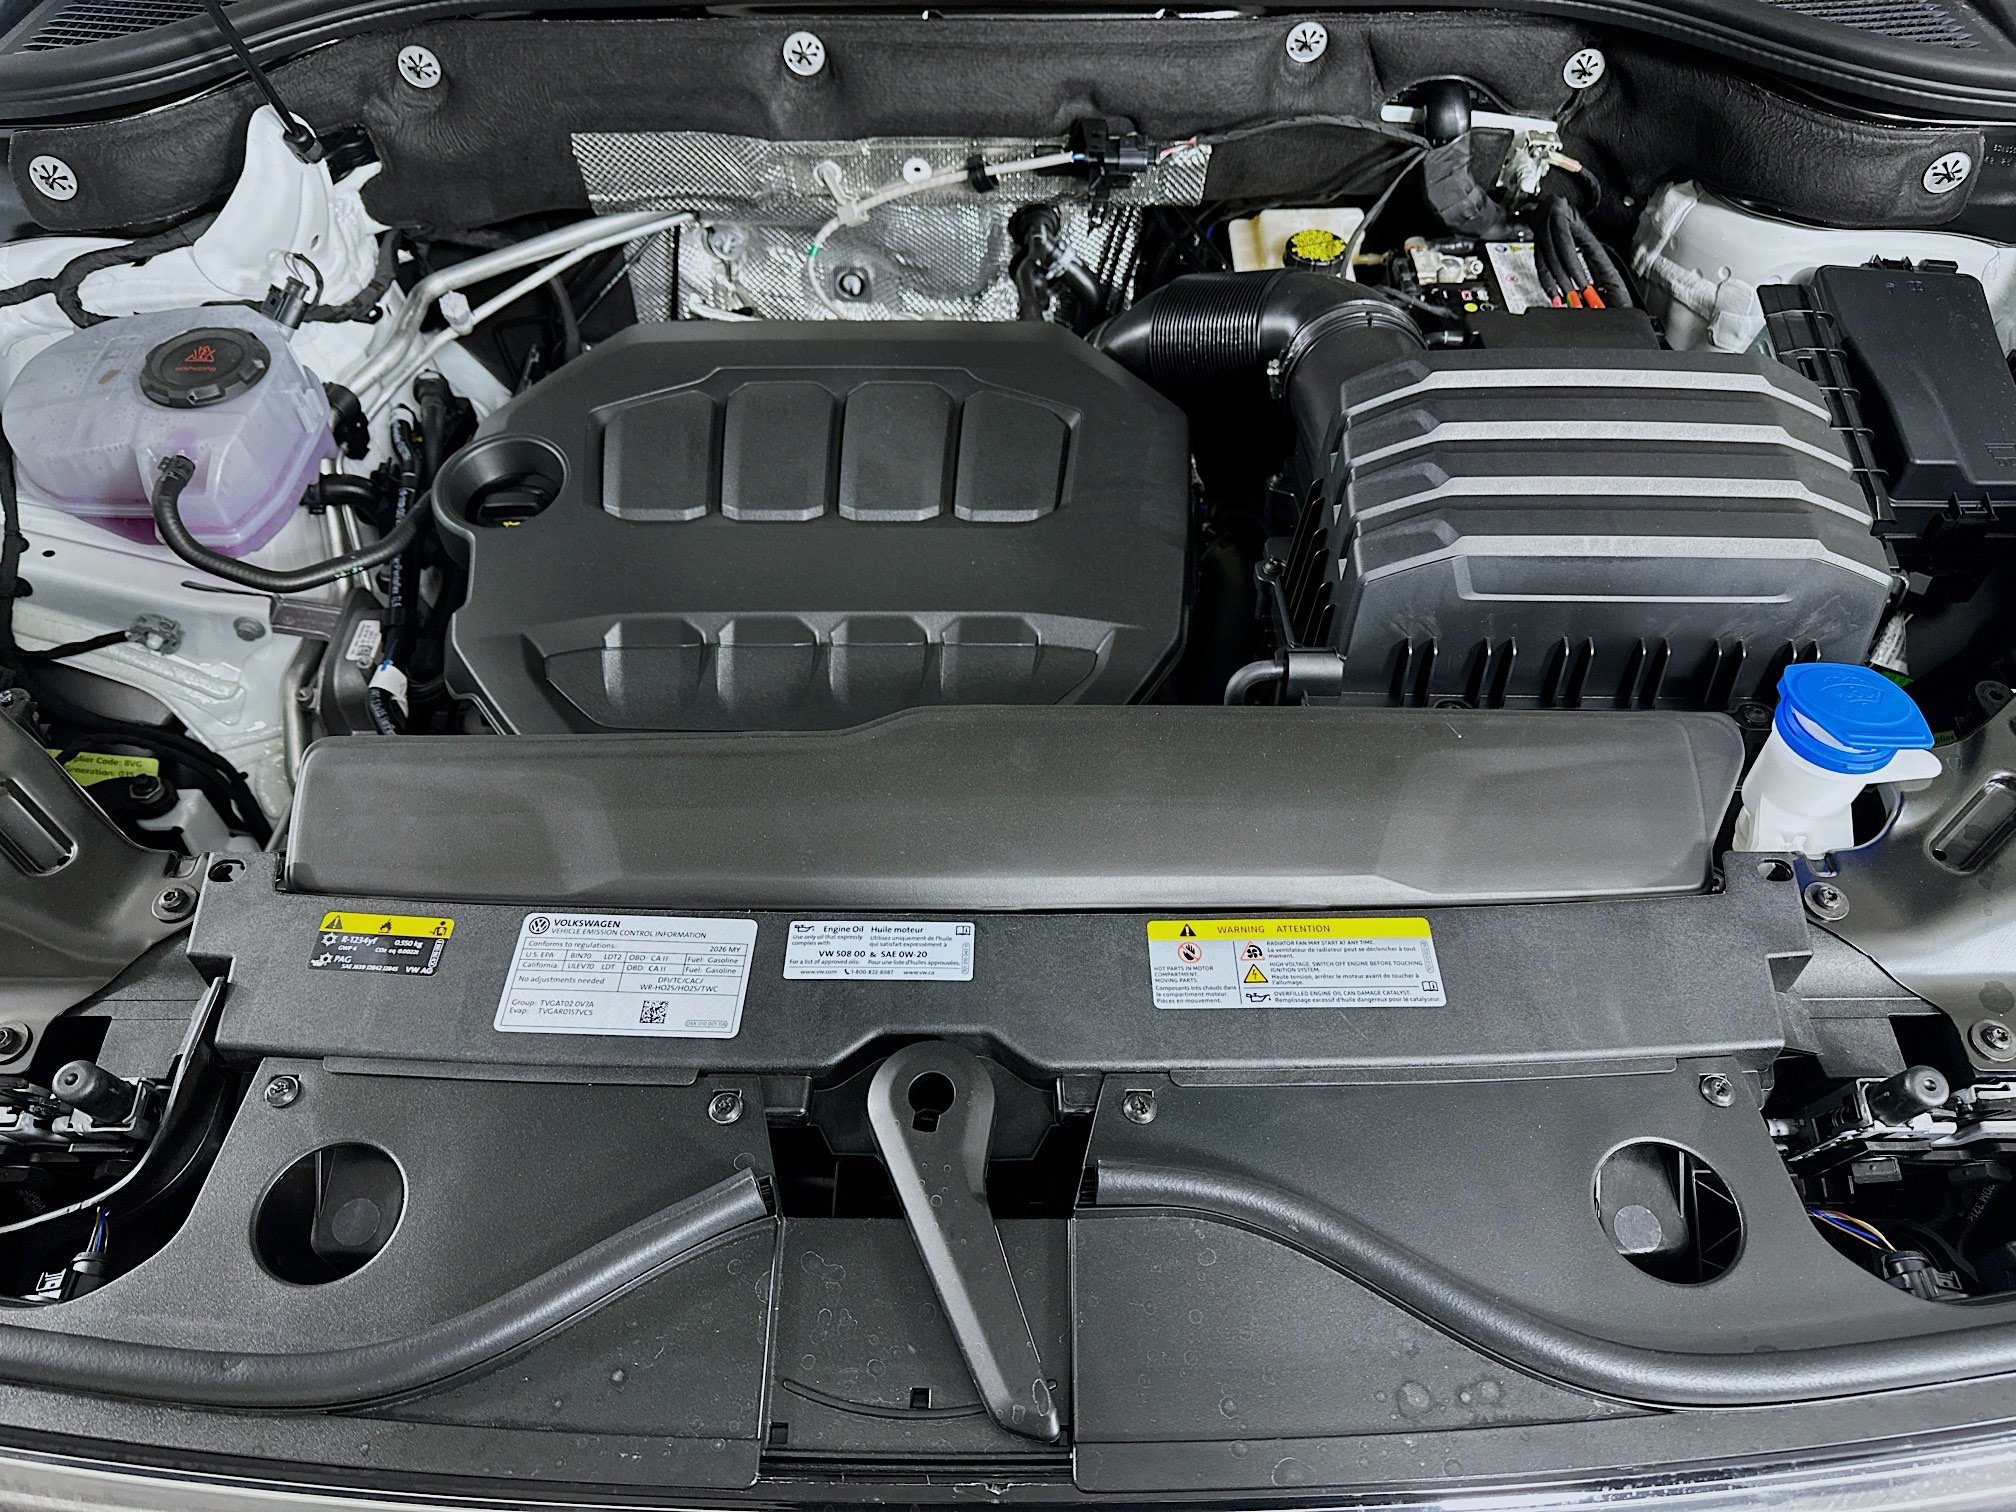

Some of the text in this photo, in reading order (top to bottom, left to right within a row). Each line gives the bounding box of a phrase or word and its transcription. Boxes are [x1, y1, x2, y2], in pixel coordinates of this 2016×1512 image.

[554, 918, 620, 928] VOLKSWAGEN
[823, 925, 850, 934] Engine
[1217, 925, 1264, 933] WARNING
[1276, 924, 1330, 932] ATTENTION
[619, 929, 653, 937] CONTROL
[340, 936, 378, 945] R-1234yf
[413, 940, 423, 948] kg
[528, 940, 563, 948] Conforms
[333, 955, 352, 963] PAG
[707, 956, 738, 964] Gasoline
[867, 959, 881, 967] Pour
[892, 959, 905, 967] liste
[705, 966, 736, 974] Gasoline
[530, 976, 575, 984] adjustments
